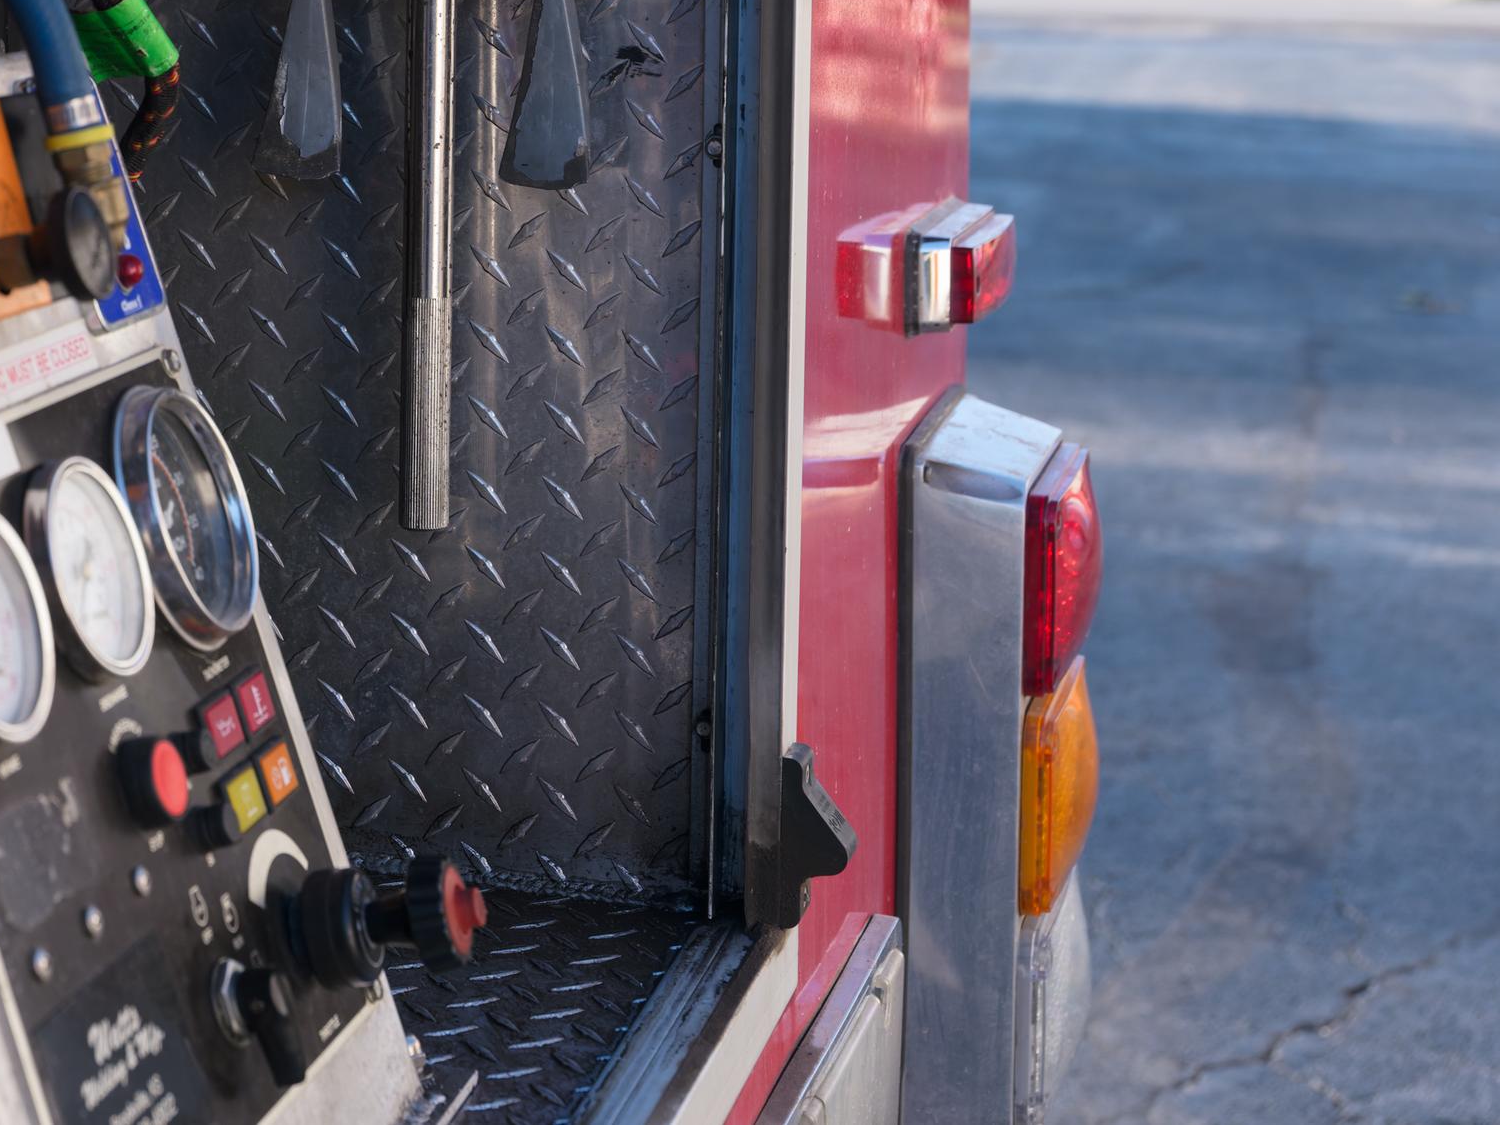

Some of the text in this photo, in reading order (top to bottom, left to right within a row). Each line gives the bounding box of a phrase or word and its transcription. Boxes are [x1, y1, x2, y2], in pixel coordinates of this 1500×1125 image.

[7, 359, 35, 385] MUST
[37, 353, 51, 371] BE
[51, 336, 91, 369] CLOSED
